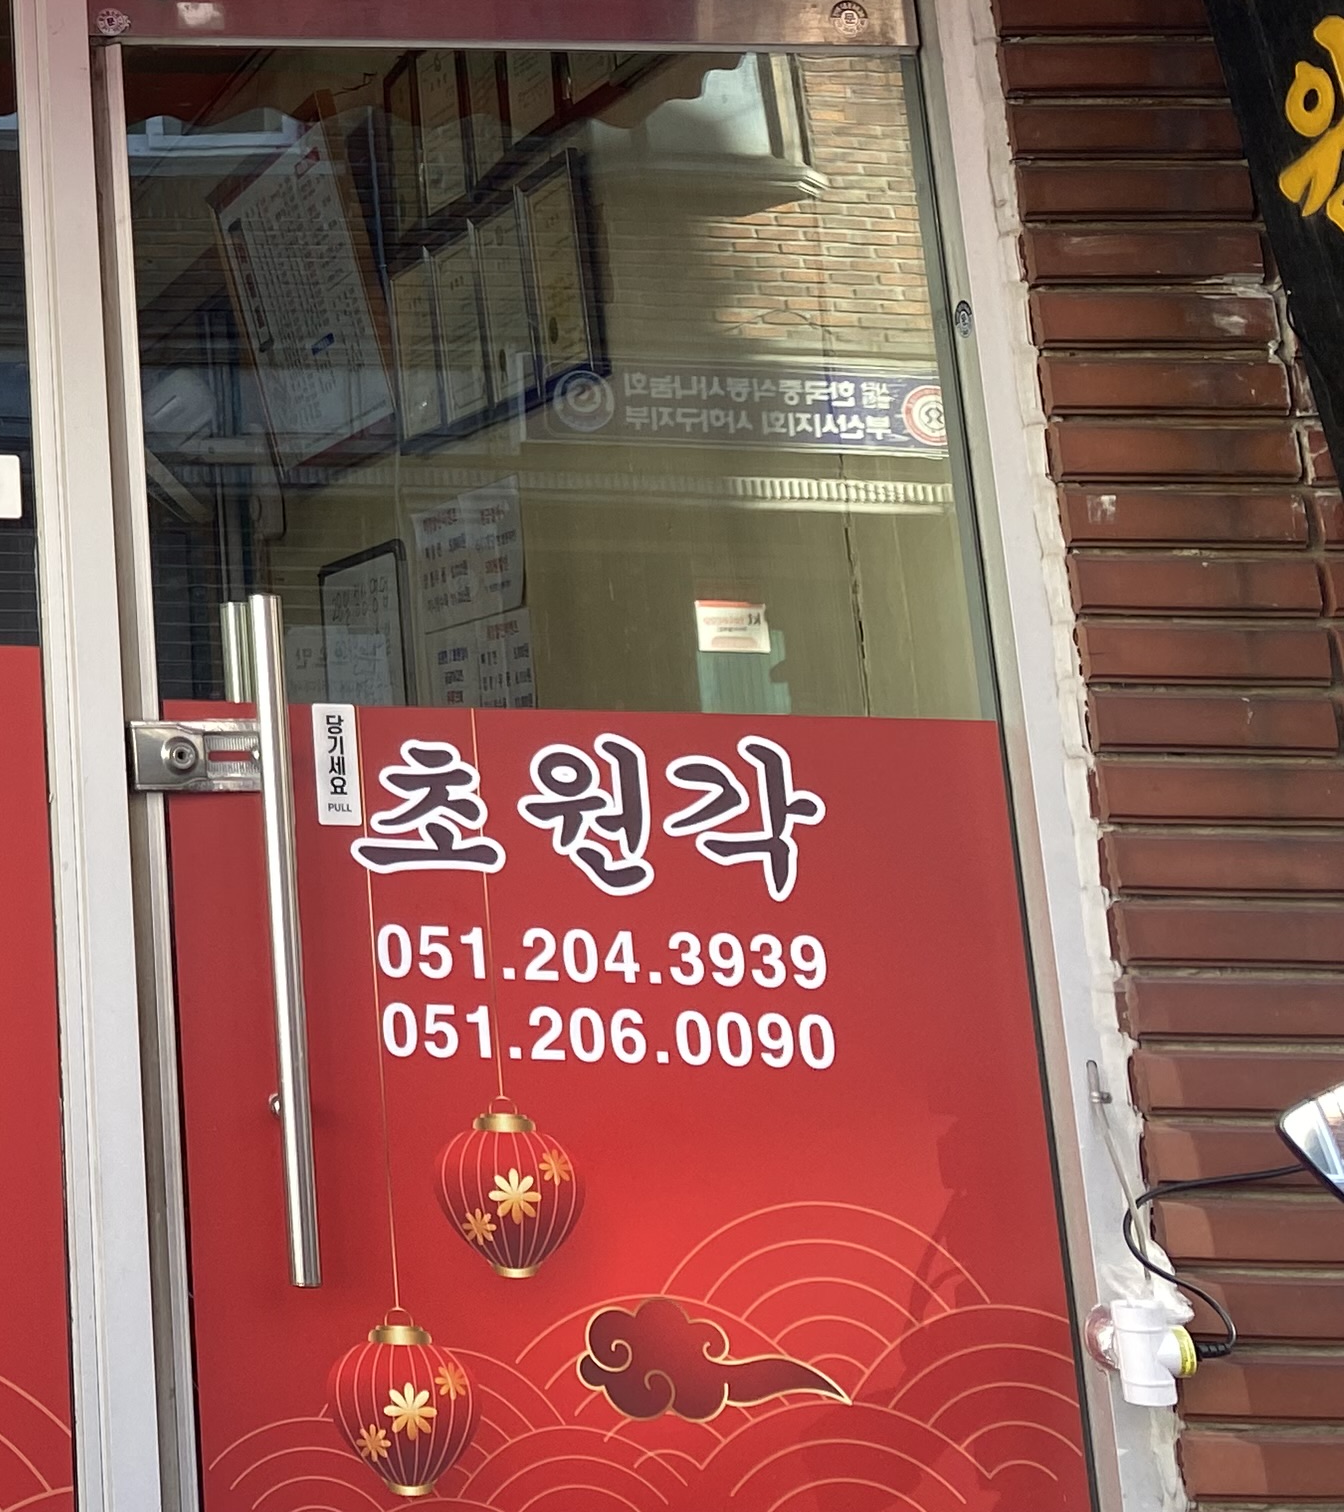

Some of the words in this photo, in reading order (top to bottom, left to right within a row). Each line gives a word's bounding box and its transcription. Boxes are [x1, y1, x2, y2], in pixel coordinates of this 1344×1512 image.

[325, 714, 349, 796] 당기세요
[327, 802, 353, 814] PULL
[350, 732, 826, 902] 초원각
[376, 923, 828, 990] 051.204.3939
[381, 1001, 837, 1070] 051.206.0090
